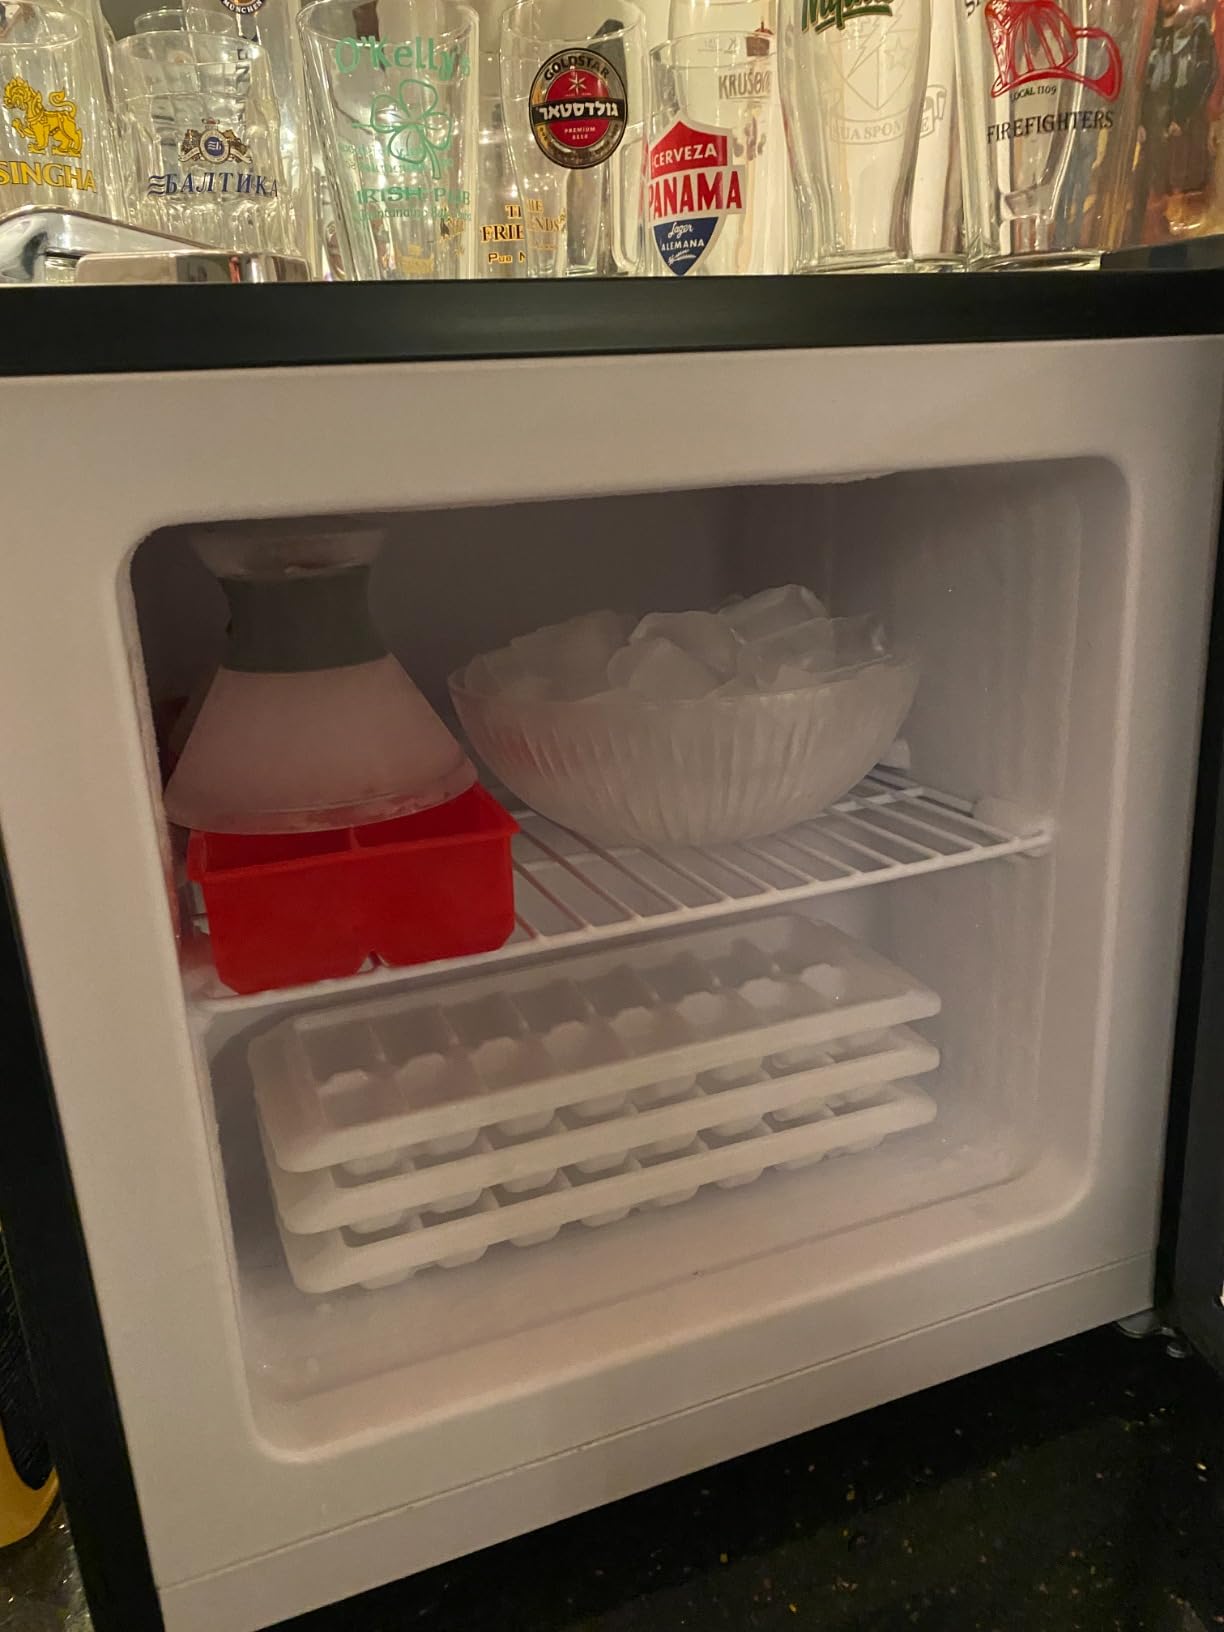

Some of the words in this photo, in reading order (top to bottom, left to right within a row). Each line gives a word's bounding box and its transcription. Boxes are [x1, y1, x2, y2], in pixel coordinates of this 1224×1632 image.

[543, 54, 610, 81] GOLDSTAR
[1037, 85, 1057, 96] 1109
[539, 101, 619, 120] גולדסטאר
[987, 110, 1114, 144] FIREFIGHTERS
[653, 143, 718, 168] CERVEZA
[0, 160, 97, 193] SINGHA
[165, 172, 278, 197] БАЛТИКА
[357, 187, 423, 204] IRISH
[648, 170, 743, 222] PANAMA
[668, 221, 695, 239] Lager
[661, 239, 705, 252] ALEMANA
